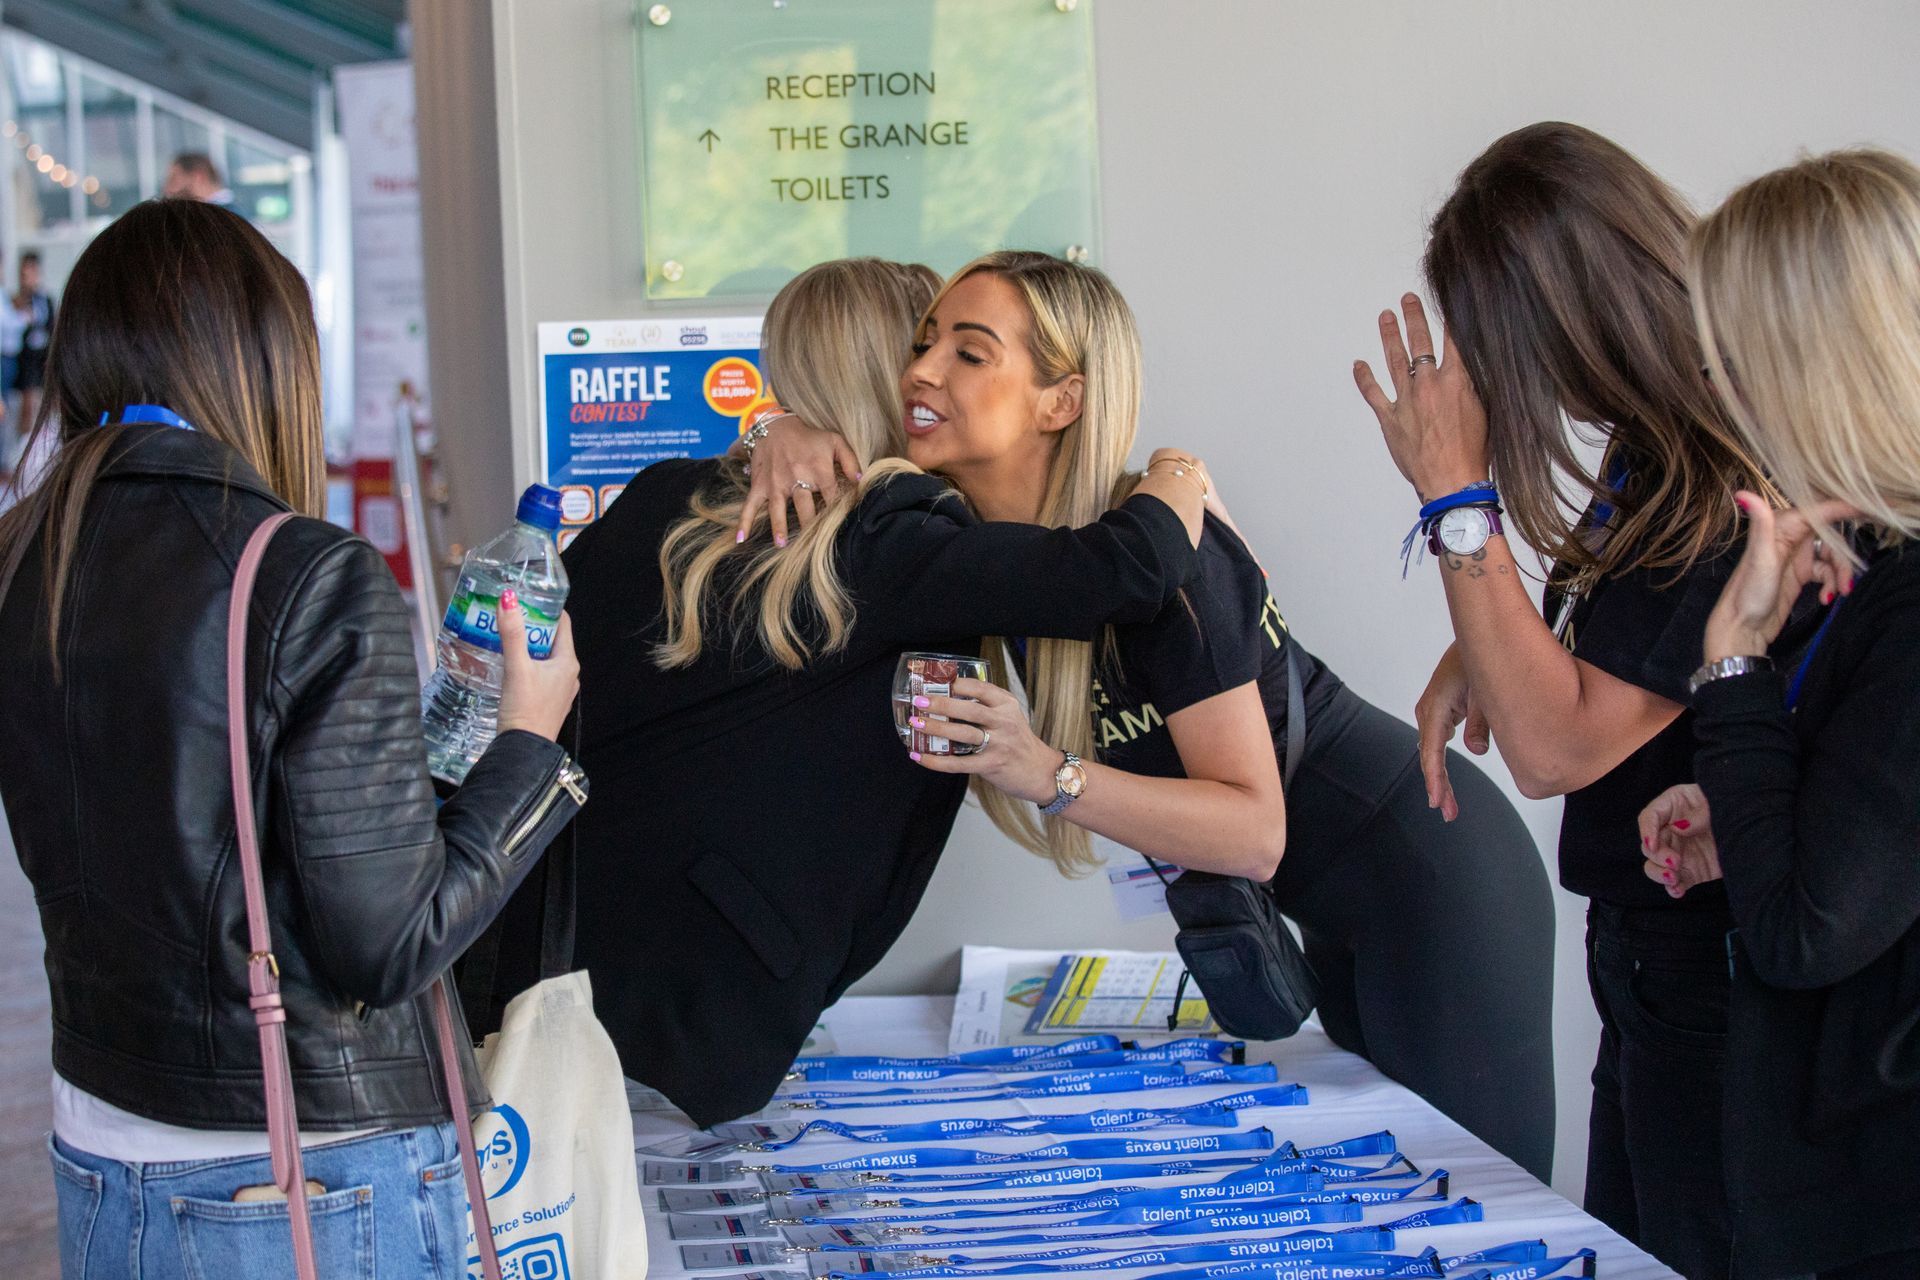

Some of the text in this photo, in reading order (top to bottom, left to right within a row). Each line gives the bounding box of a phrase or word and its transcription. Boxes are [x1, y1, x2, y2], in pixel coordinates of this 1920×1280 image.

[766, 71, 936, 100] RECEPTION
[769, 121, 969, 151] THE GRANGE
[771, 175, 890, 201] TOILETS
[570, 366, 671, 403] RAFFLE
[570, 401, 651, 423] CONTEST
[475, 611, 553, 646] BUON
[1099, 702, 1165, 748] AM
[1124, 1052, 1165, 1061] nexus
[852, 1069, 940, 1080] talent nexus
[1049, 1082, 1091, 1092] nexus
[941, 1120, 983, 1132] nexus
[1091, 1111, 1133, 1126] talent
[1126, 1137, 1220, 1153] talent nexus
[1298, 1146, 1345, 1159] talent
[822, 1154, 917, 1170] talent nexus
[1005, 1167, 1103, 1187] talent nexus
[1181, 1181, 1274, 1199] talent nexus
[1352, 1192, 1400, 1203] nexus
[1143, 1207, 1191, 1222] talent
[1211, 1209, 1311, 1227] talent nexus
[1230, 1238, 1333, 1256] talent nexus
[1115, 1253, 1166, 1267] talent
[888, 1267, 940, 1277] talent
[1276, 1266, 1385, 1280] talent nexus
